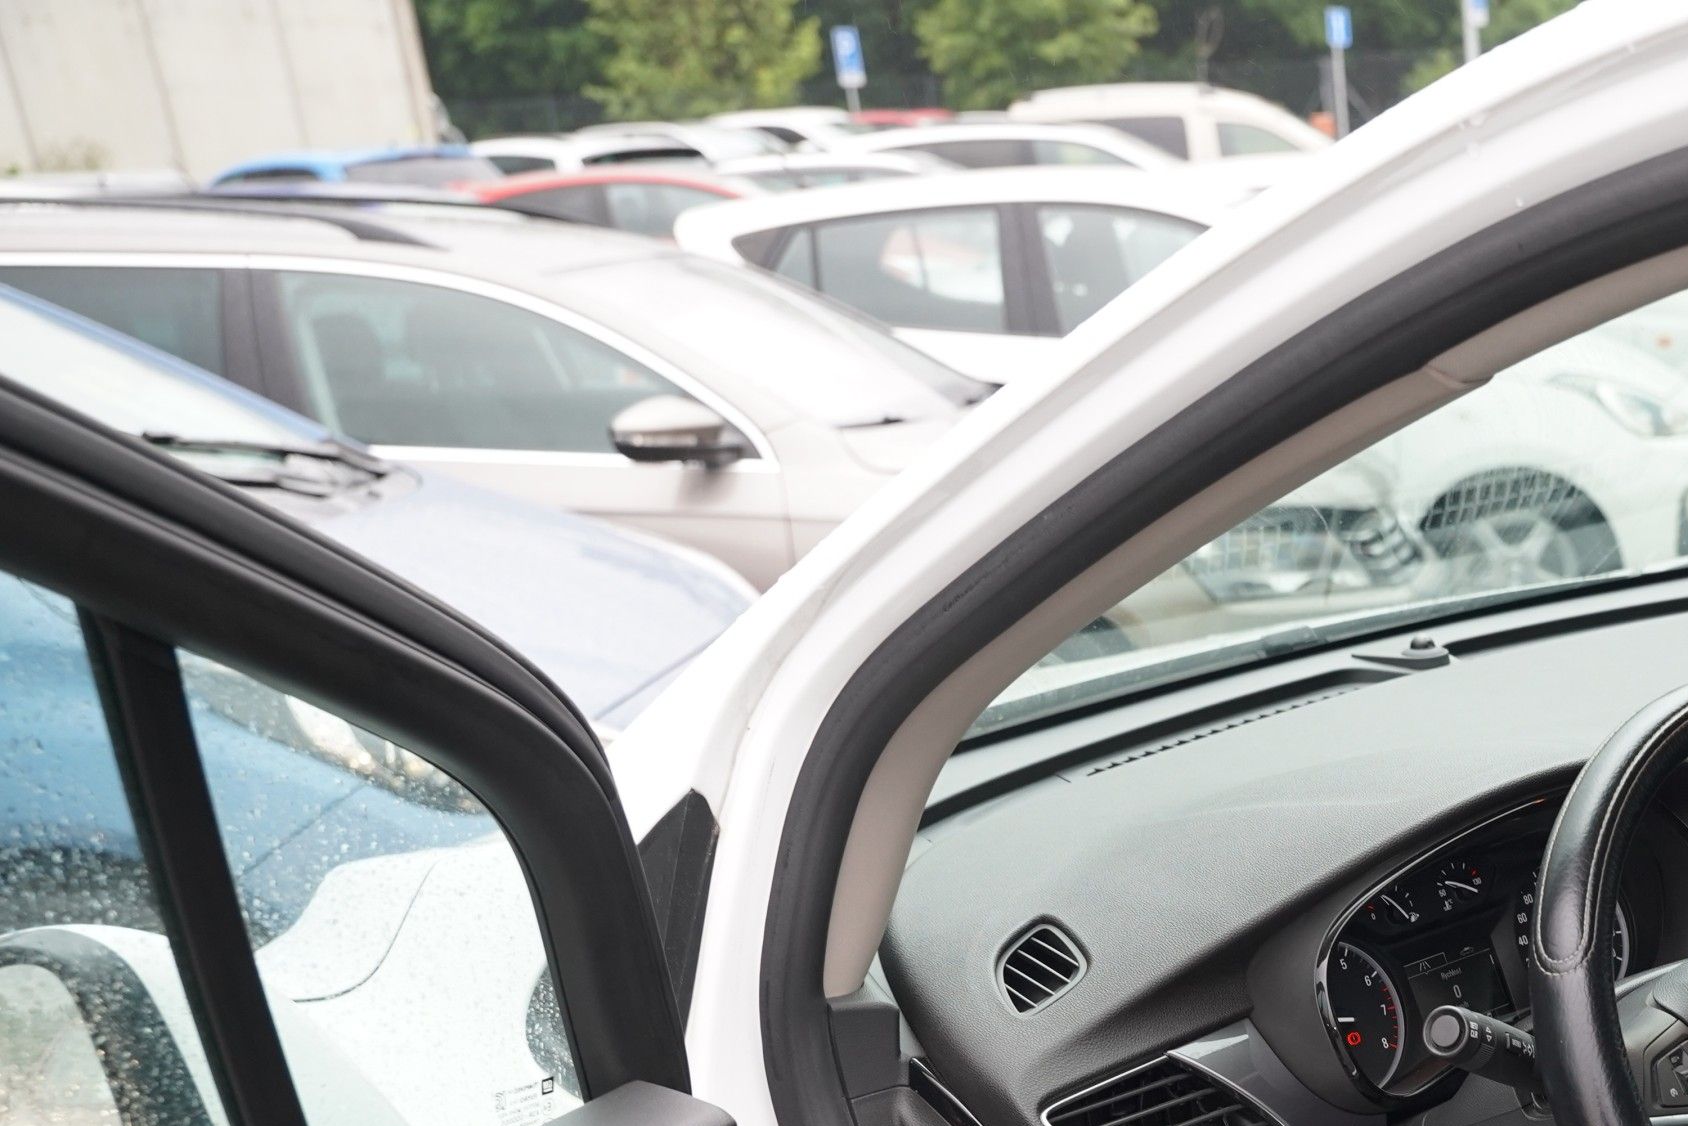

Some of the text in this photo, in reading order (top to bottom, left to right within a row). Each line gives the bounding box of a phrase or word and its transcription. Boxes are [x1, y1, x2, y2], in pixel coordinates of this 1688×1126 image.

[1523, 893, 1533, 905] 80
[1517, 913, 1528, 924] 60
[1518, 935, 1529, 946] 40
[1339, 958, 1347, 970] 5
[1364, 975, 1372, 987] 6
[1453, 984, 1462, 998] 0
[1380, 1004, 1387, 1016] 7
[1381, 1037, 1389, 1049] 8
